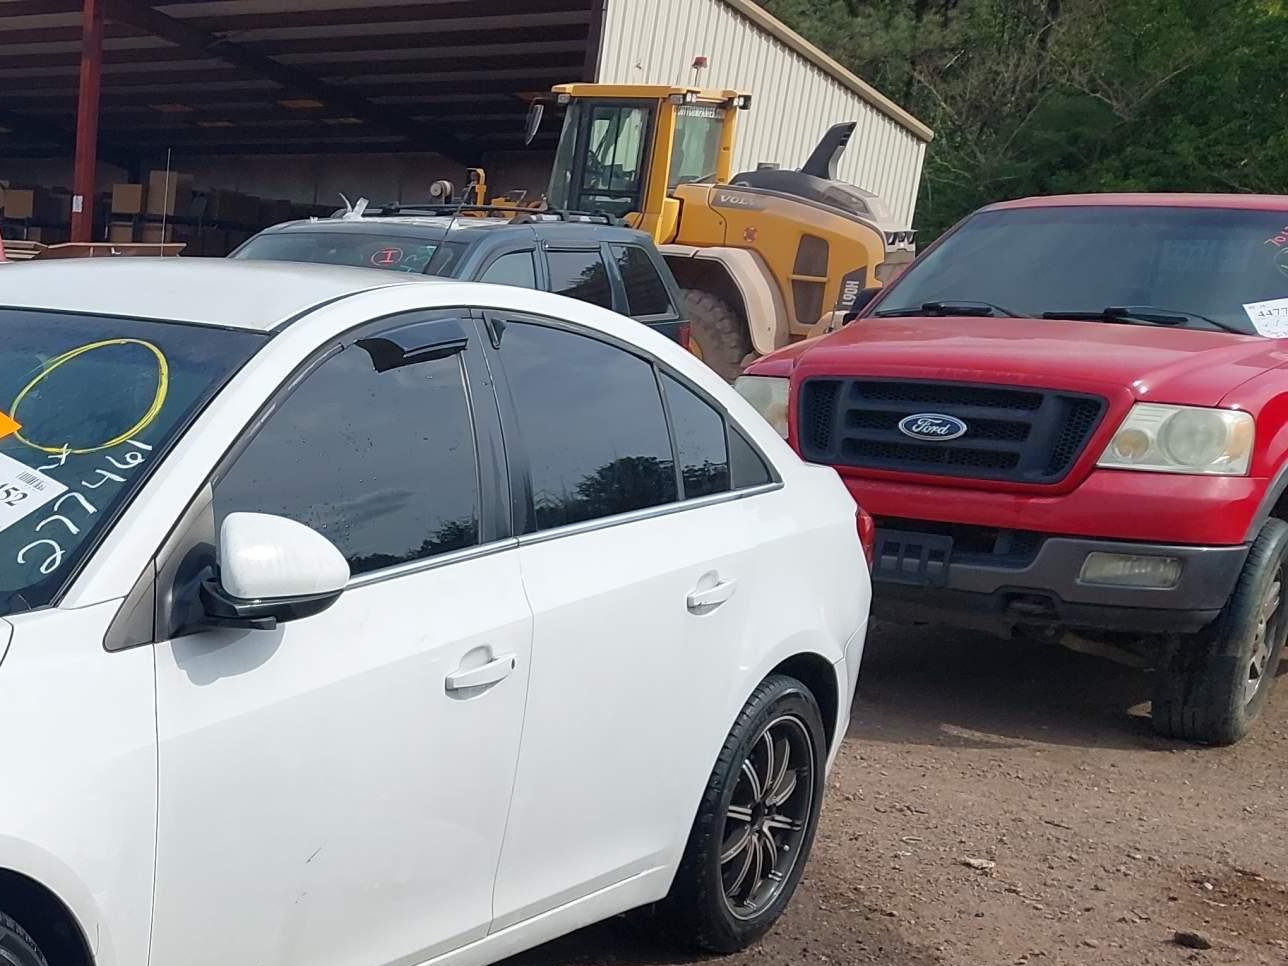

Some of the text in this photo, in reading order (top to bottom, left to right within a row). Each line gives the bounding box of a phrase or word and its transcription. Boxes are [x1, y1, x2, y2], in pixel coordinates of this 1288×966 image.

[842, 280, 860, 306] L90H
[912, 418, 951, 435] Ford
[16, 439, 154, 575] 277461
